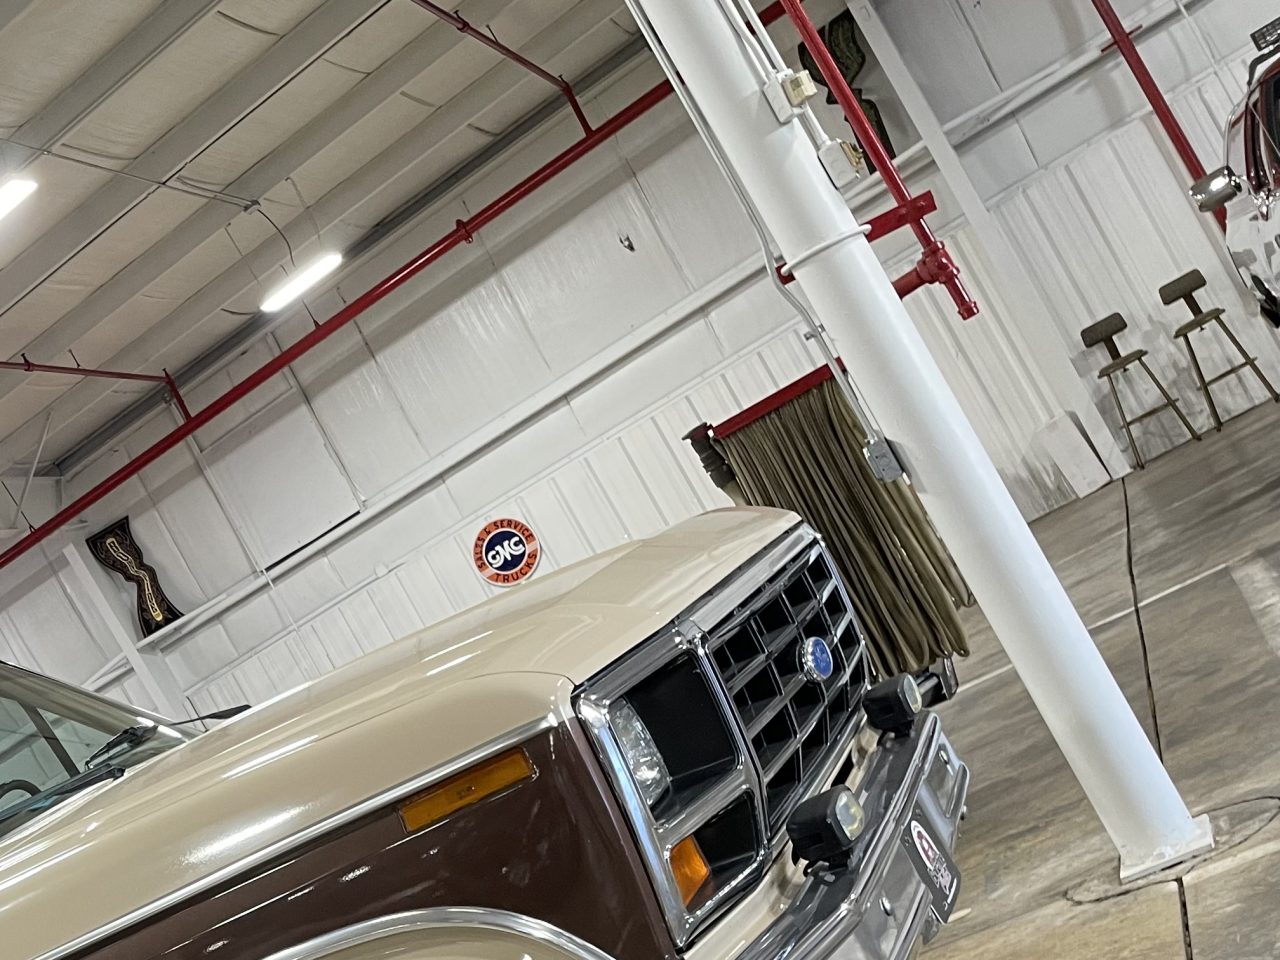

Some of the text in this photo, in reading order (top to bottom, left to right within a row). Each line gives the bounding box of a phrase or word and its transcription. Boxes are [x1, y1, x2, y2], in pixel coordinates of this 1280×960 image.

[474, 519, 534, 569] SALES & SERVICE
[487, 536, 526, 568] GMC
[495, 553, 538, 583] TRUCKS
